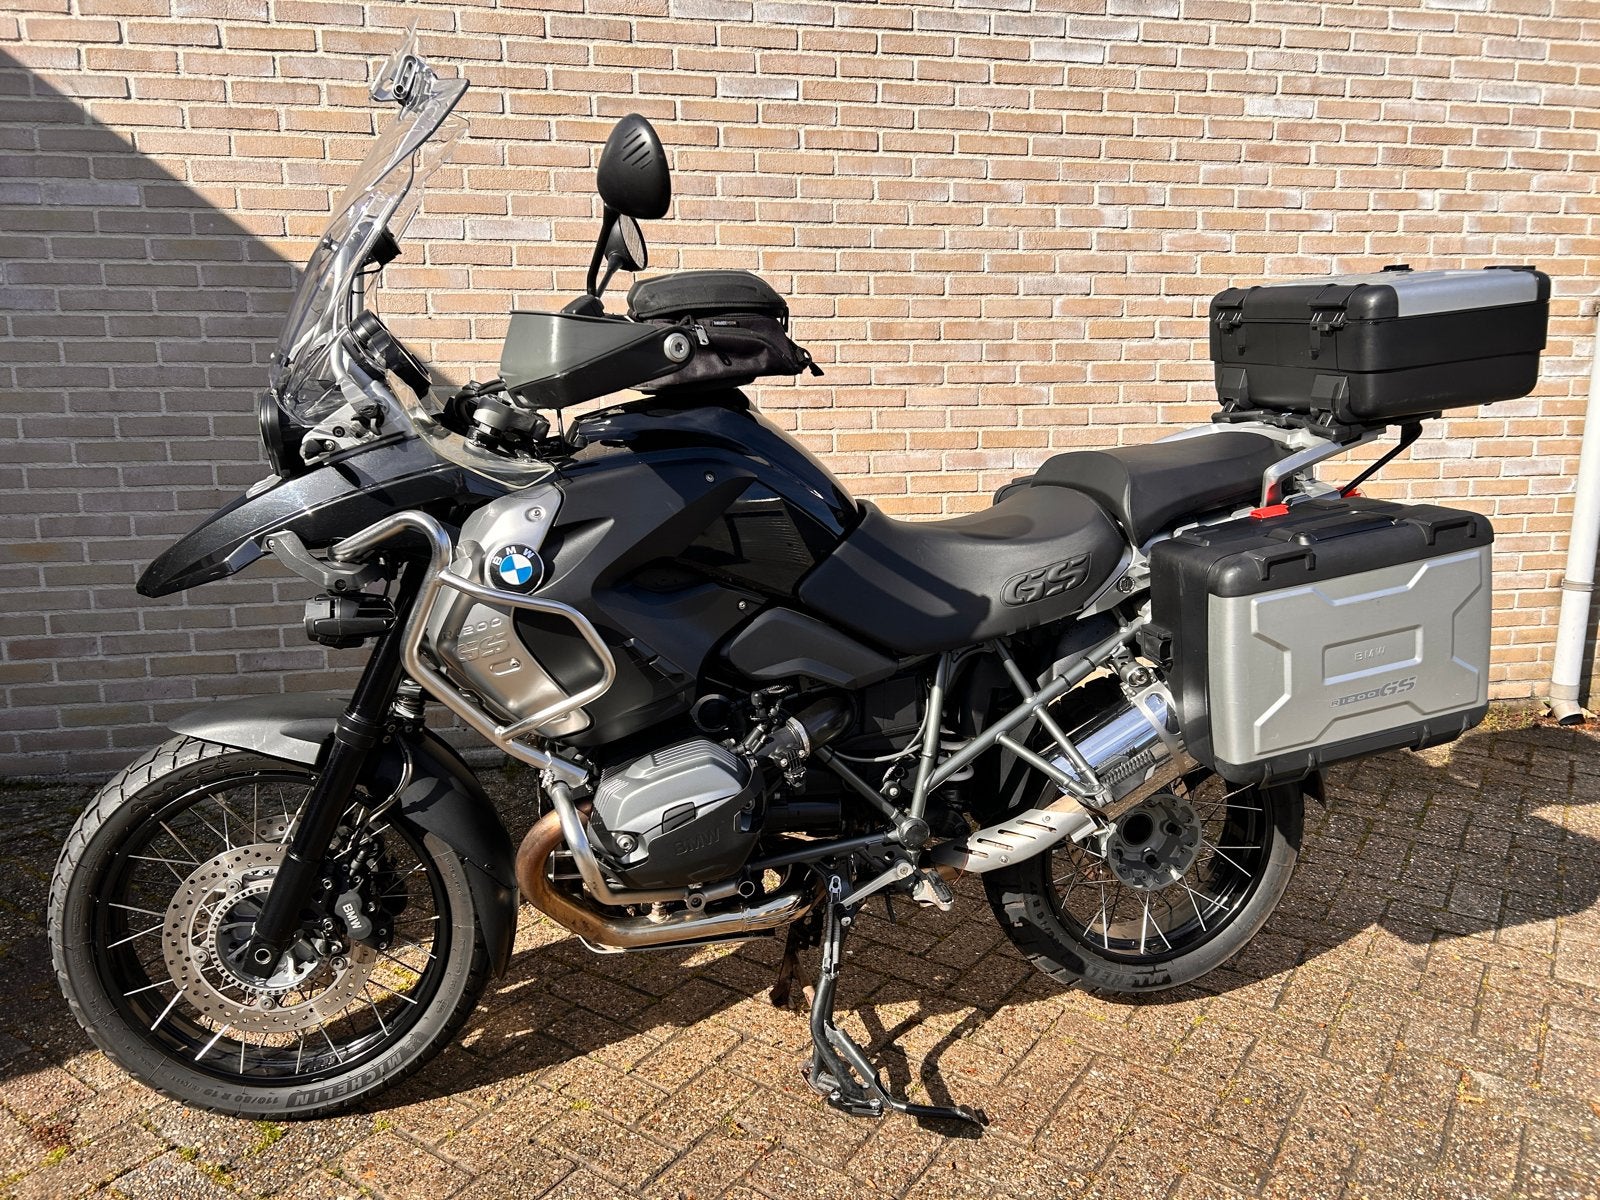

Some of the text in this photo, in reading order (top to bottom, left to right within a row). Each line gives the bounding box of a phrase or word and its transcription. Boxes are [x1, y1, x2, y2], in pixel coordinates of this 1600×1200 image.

[492, 546, 535, 566] BMW
[1004, 555, 1088, 606] GS
[1354, 646, 1386, 661] BMW
[674, 827, 720, 856] BMW
[342, 903, 362, 929] BMW
[294, 1052, 402, 1107] MICHELIN
[203, 1088, 279, 1106] 110/80 R 19
